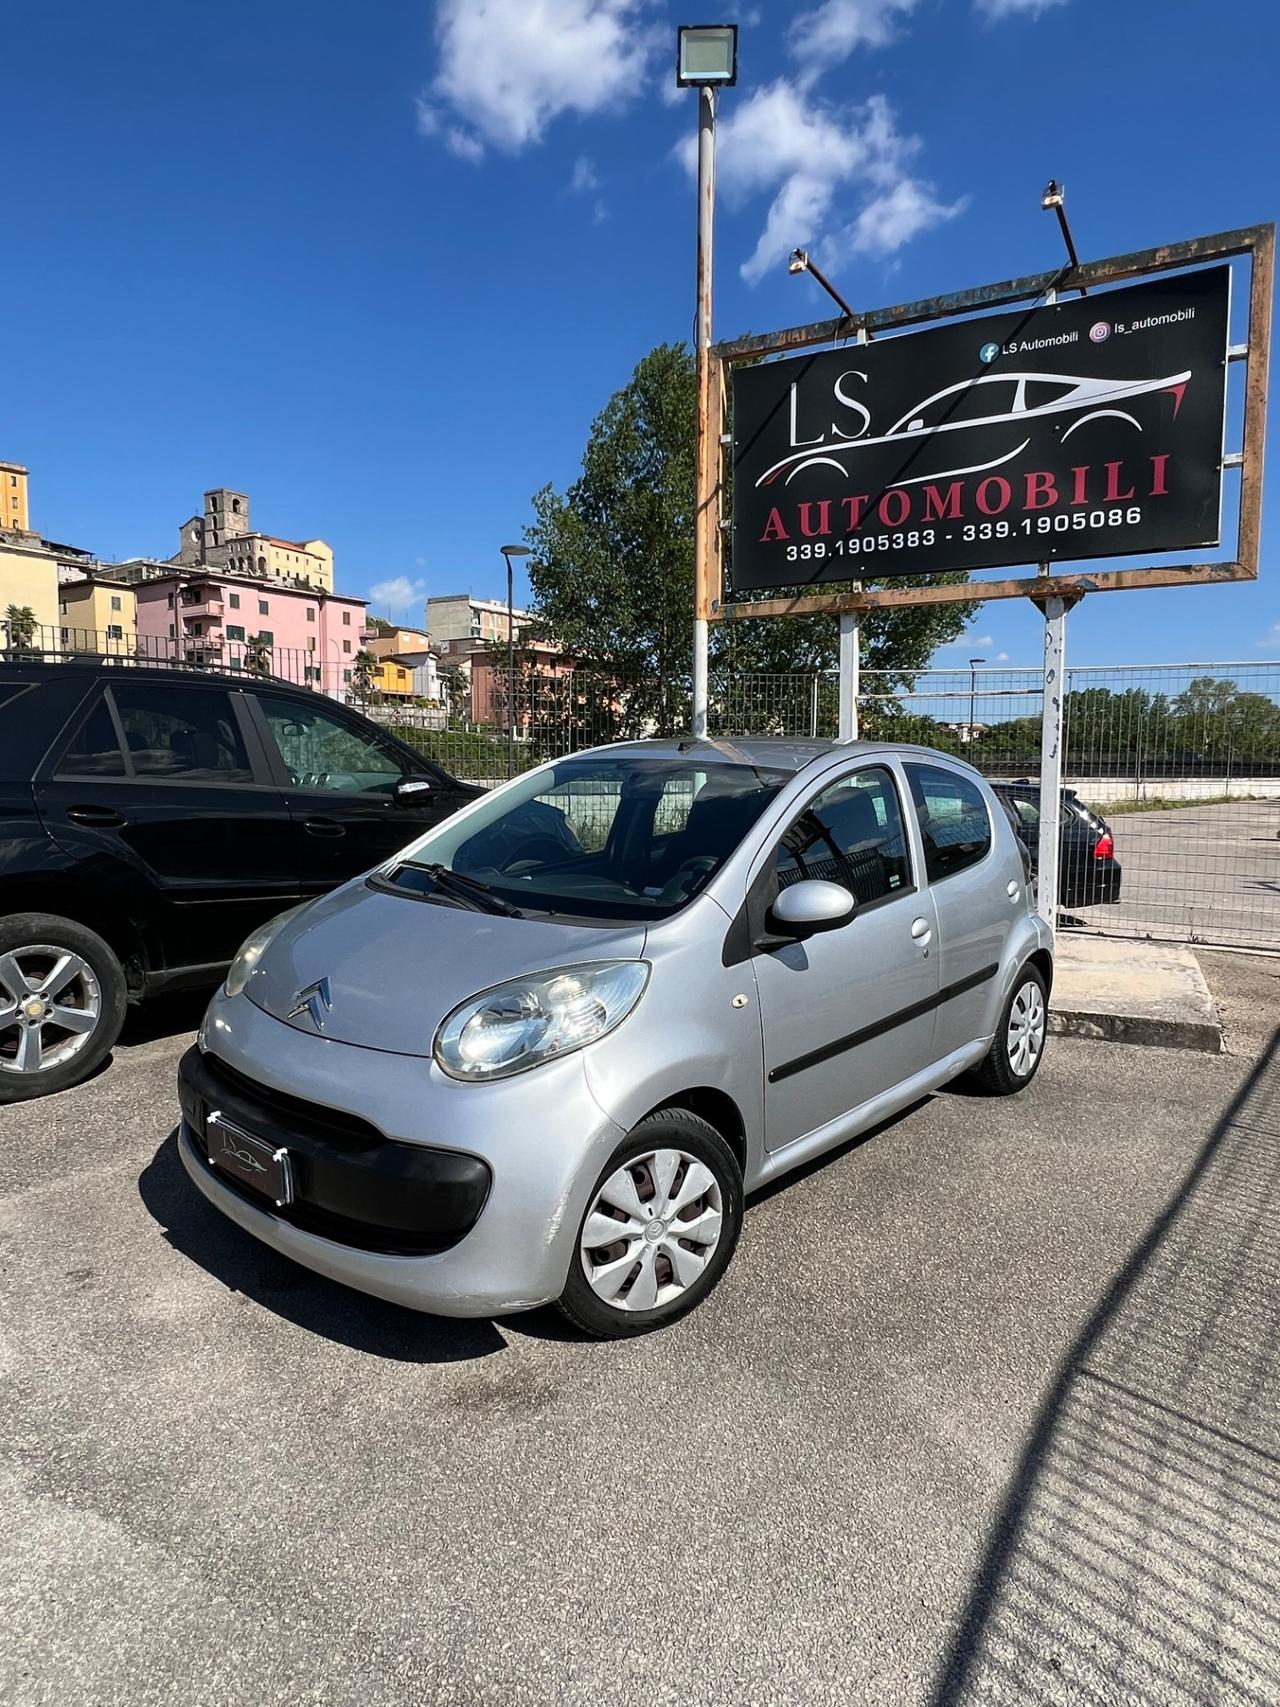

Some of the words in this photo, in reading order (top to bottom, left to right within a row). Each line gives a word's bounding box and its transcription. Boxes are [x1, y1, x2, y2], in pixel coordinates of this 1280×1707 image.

[1114, 307, 1195, 334] ls_automobili
[1002, 342, 1017, 355] LS
[1019, 331, 1079, 352] Automobili
[758, 454, 1171, 542] AUTOMOBILI
[786, 529, 935, 562] 339.1905383
[963, 507, 1142, 541] 339.1905086
